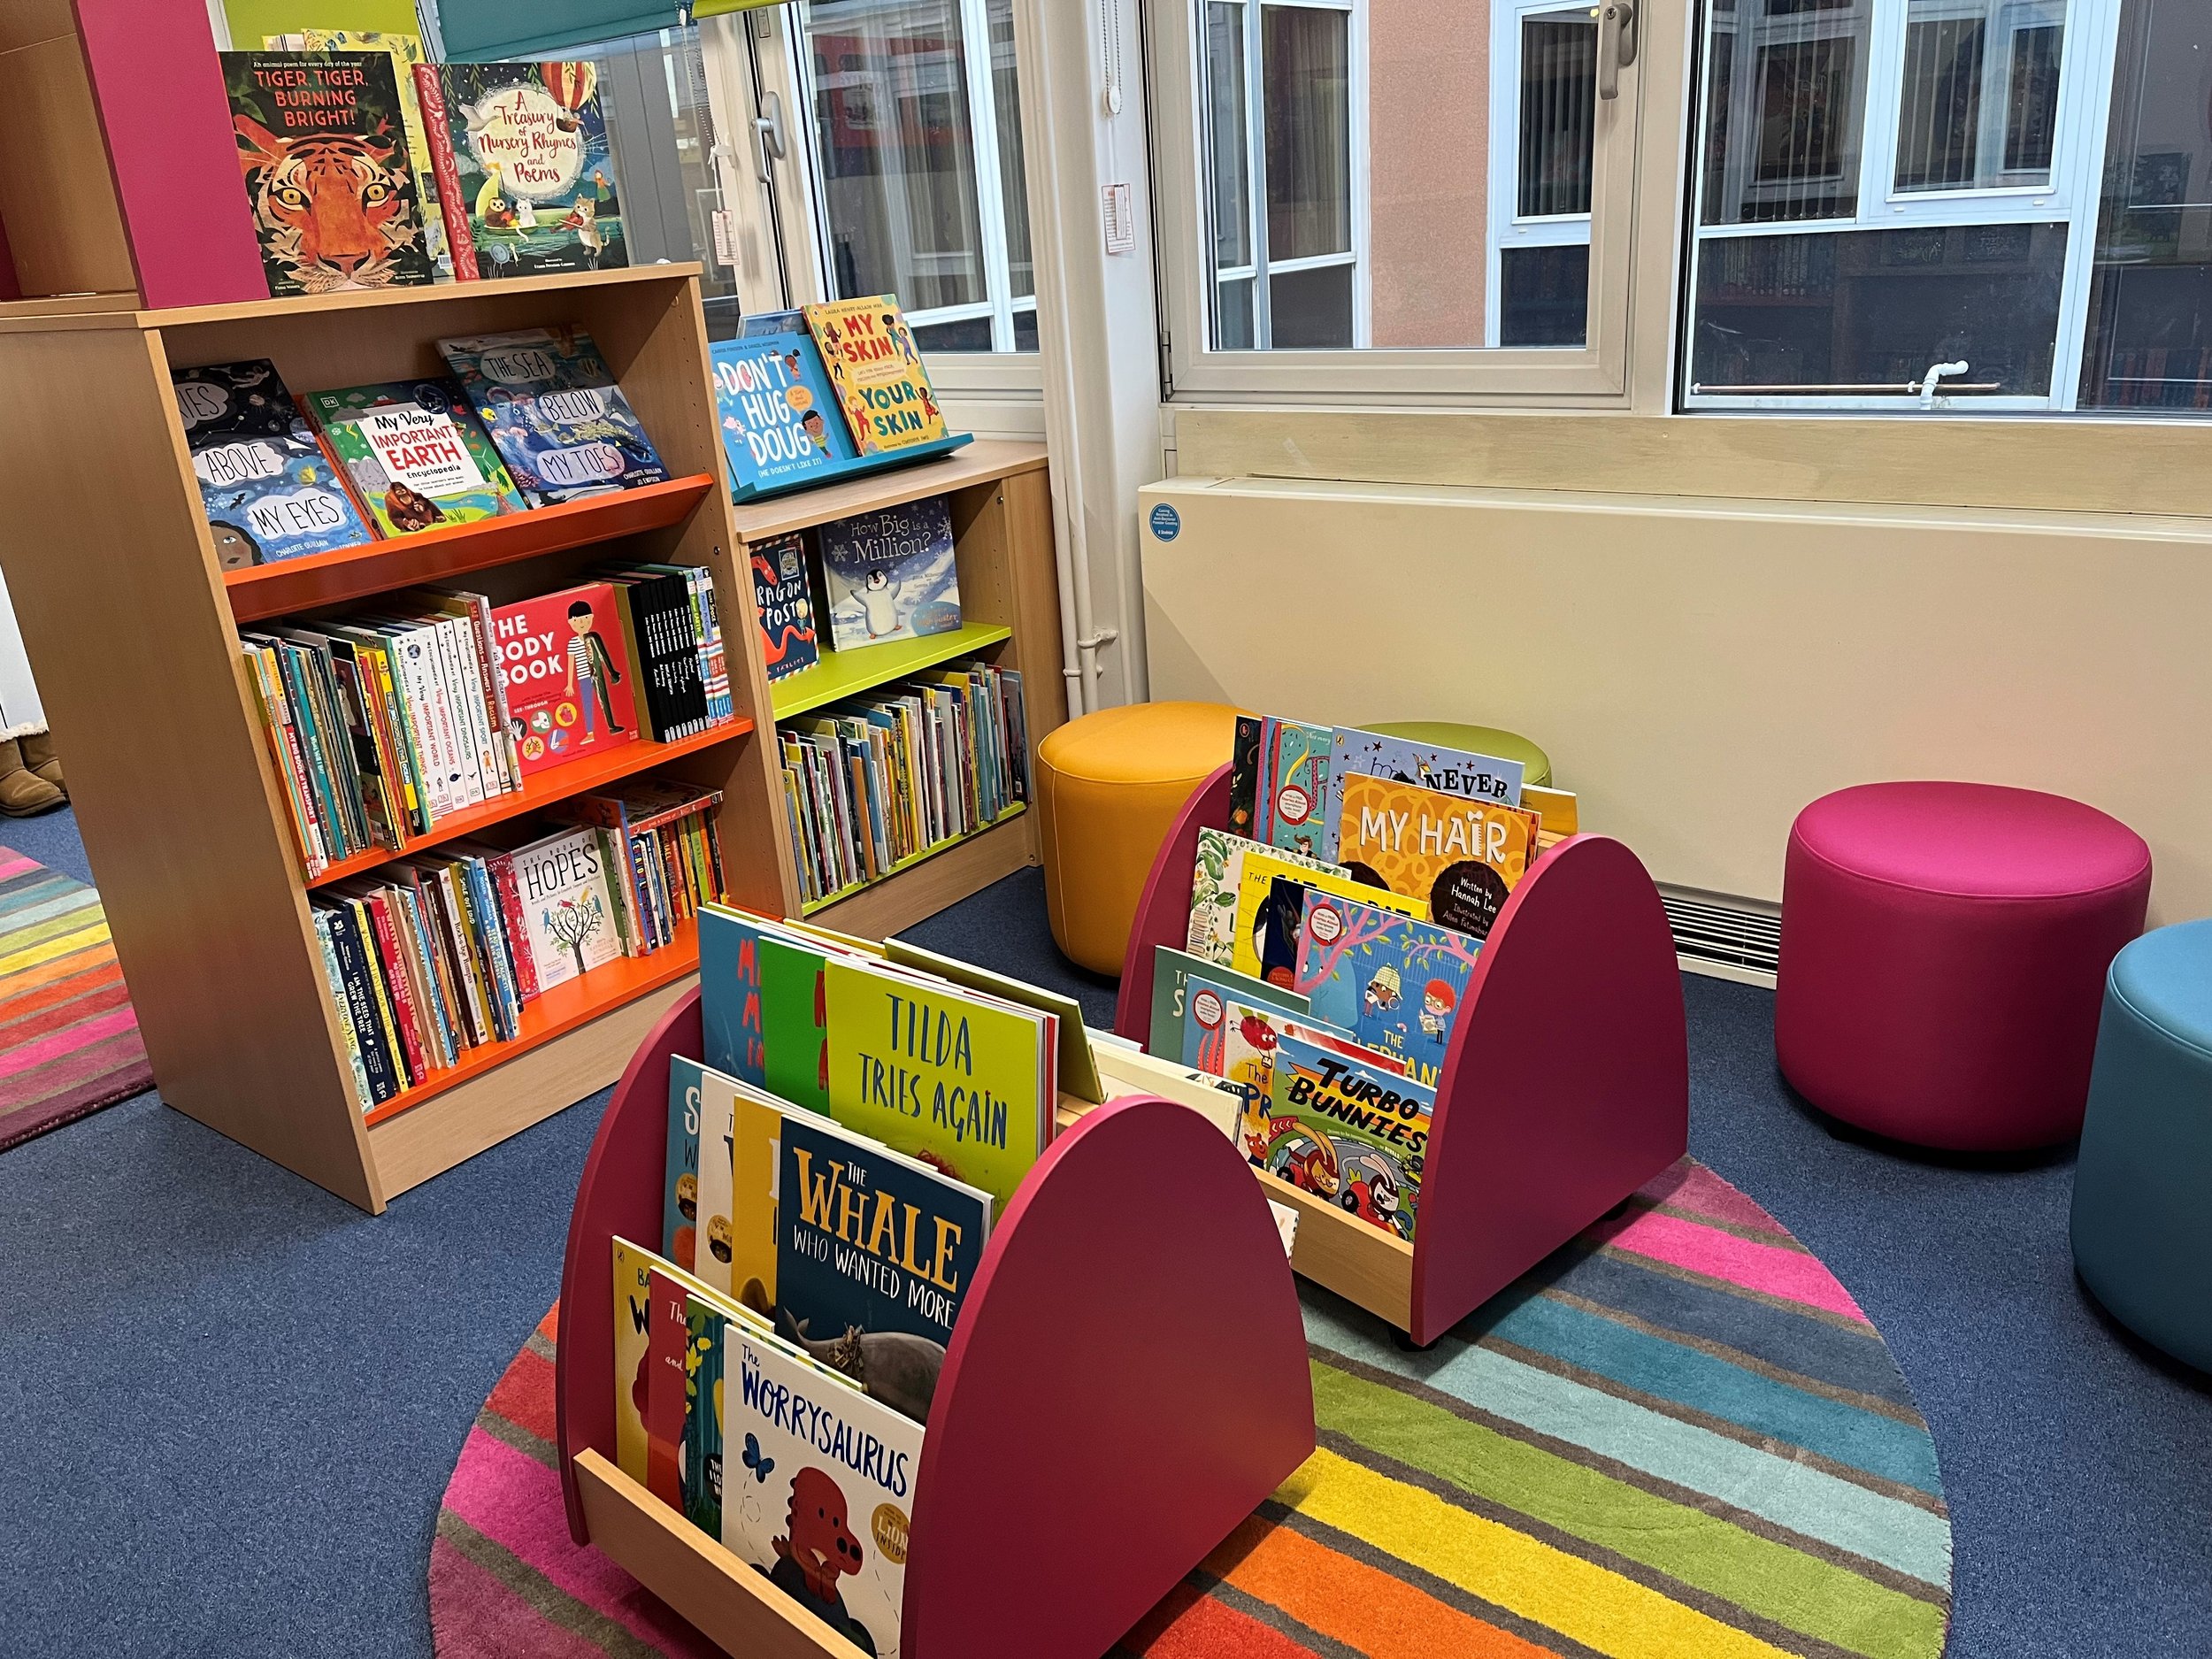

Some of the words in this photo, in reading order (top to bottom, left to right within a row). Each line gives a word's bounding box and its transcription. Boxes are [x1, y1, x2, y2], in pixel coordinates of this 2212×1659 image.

[254, 70, 312, 88] TIGER,
[313, 70, 369, 87] TIGER,
[274, 90, 357, 107] BURNING
[515, 91, 528, 111] A
[284, 109, 356, 127] BRIGHT!
[494, 105, 555, 134] Treasury
[518, 126, 527, 136] of
[479, 134, 529, 157] Nursery
[532, 131, 576, 158] Rhymes
[514, 162, 560, 183] Poems
[527, 154, 544, 165] and
[843, 313, 874, 338] MY
[842, 336, 894, 363] SKIN
[484, 357, 517, 379] THE
[514, 351, 551, 379] SEA
[718, 353, 787, 396] DON'T
[178, 386, 219, 419] IES
[542, 389, 601, 421] BELOW
[858, 380, 917, 410] YOUR
[375, 416, 398, 431] My
[400, 411, 434, 426] Very
[741, 390, 791, 429] HUG
[874, 410, 924, 436] SKIN
[373, 425, 453, 449] IMPORTANT
[747, 422, 811, 466] DOUG
[205, 446, 273, 483] ABOVE
[387, 441, 462, 471] EARTH
[542, 453, 572, 482] MY
[570, 446, 620, 475] TOES
[770, 464, 795, 475] DOESN'T
[797, 459, 811, 470] LIKE
[407, 465, 461, 479] Encyclopedia
[252, 506, 286, 535] MY
[286, 496, 340, 529] EYES
[850, 522, 879, 537] How
[879, 514, 910, 536] Big
[912, 521, 921, 530] is
[276, 541, 303, 557] CHARLOTTE
[852, 531, 931, 564] Million?
[757, 580, 802, 606] RAGON
[766, 601, 797, 630] POST
[472, 620, 485, 655] Questions
[480, 662, 492, 692] Answers
[417, 685, 426, 701] Very
[469, 677, 479, 692] Very
[421, 703, 434, 742] IMPORTANT
[450, 678, 459, 693] Very
[455, 694, 465, 726] IMPORTANT
[460, 726, 472, 760] DINOSAURS
[472, 694, 484, 726] IMPORTANT
[487, 700, 499, 727] Racism
[288, 732, 296, 743] MY
[438, 706, 449, 740] IMPORTANT
[445, 741, 455, 764] OCEANS
[479, 726, 488, 744] SPORT
[290, 742, 299, 755] BIG
[429, 742, 440, 766] WORLD
[294, 757, 303, 773] BOOK
[1424, 770, 1508, 798] NEVER
[300, 780, 315, 818] TRANSPORT
[1360, 807, 1409, 852] MY
[1420, 810, 1507, 864] HAIR
[523, 855, 541, 866] THE
[549, 842, 572, 855] BOOK
[581, 834, 592, 843] OF
[524, 843, 598, 901] HOPES
[1248, 872, 1267, 885] THE
[459, 877, 468, 895] SMILE
[1451, 885, 1480, 907] Hannah
[1483, 897, 1496, 913] Lee
[1460, 877, 1482, 894] Written
[1485, 888, 1492, 900] by
[453, 922, 466, 957] Rock-a-bye
[461, 958, 472, 984] Rumpus
[347, 981, 357, 1001] GREW
[356, 987, 365, 1001] THE
[352, 1001, 361, 1016] THE
[359, 1001, 369, 1018] SEED
[356, 1015, 365, 1033] TREE
[365, 1018, 373, 1035] THAT
[885, 993, 973, 1076] TILDA
[1383, 1030, 1405, 1049] THE
[1246, 1063, 1269, 1084] The
[858, 1052, 921, 1118] TRIES
[933, 1080, 1008, 1151] AGAIN
[1317, 1057, 1419, 1121] TURBO
[1287, 1076, 1428, 1153] BUNNIES
[847, 1161, 868, 1187] THE
[793, 1146, 962, 1293] WHALE
[794, 1225, 828, 1262] WHO
[834, 1245, 901, 1299] WANTED
[908, 1279, 956, 1329] MORE
[665, 1356, 683, 1371] and
[741, 1342, 760, 1368] The
[741, 1361, 909, 1498] WORRYSAURUS
[878, 1516, 908, 1549] LION
